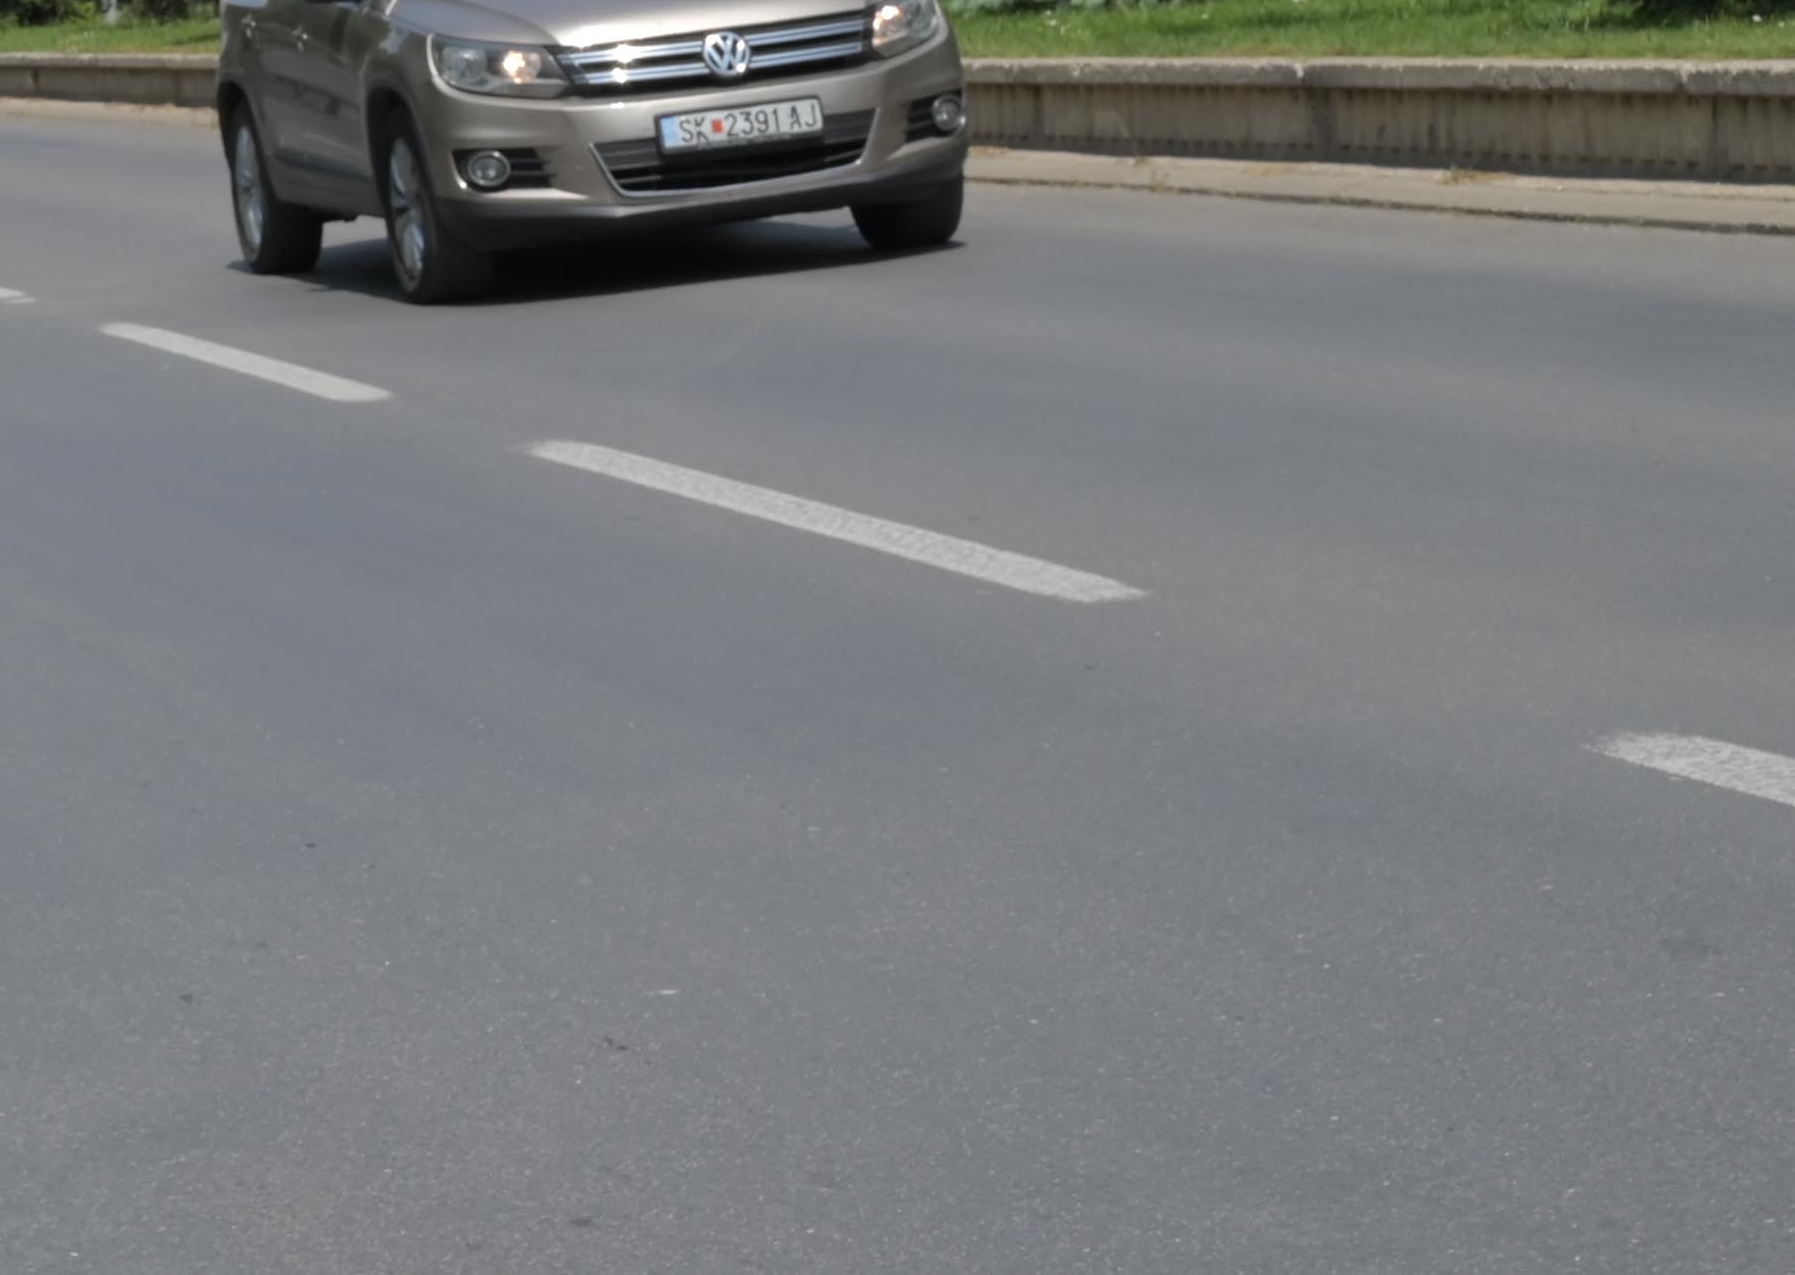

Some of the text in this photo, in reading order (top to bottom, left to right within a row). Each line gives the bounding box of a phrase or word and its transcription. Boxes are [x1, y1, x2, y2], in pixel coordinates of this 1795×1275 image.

[679, 103, 818, 147] SK 2391 AJ
